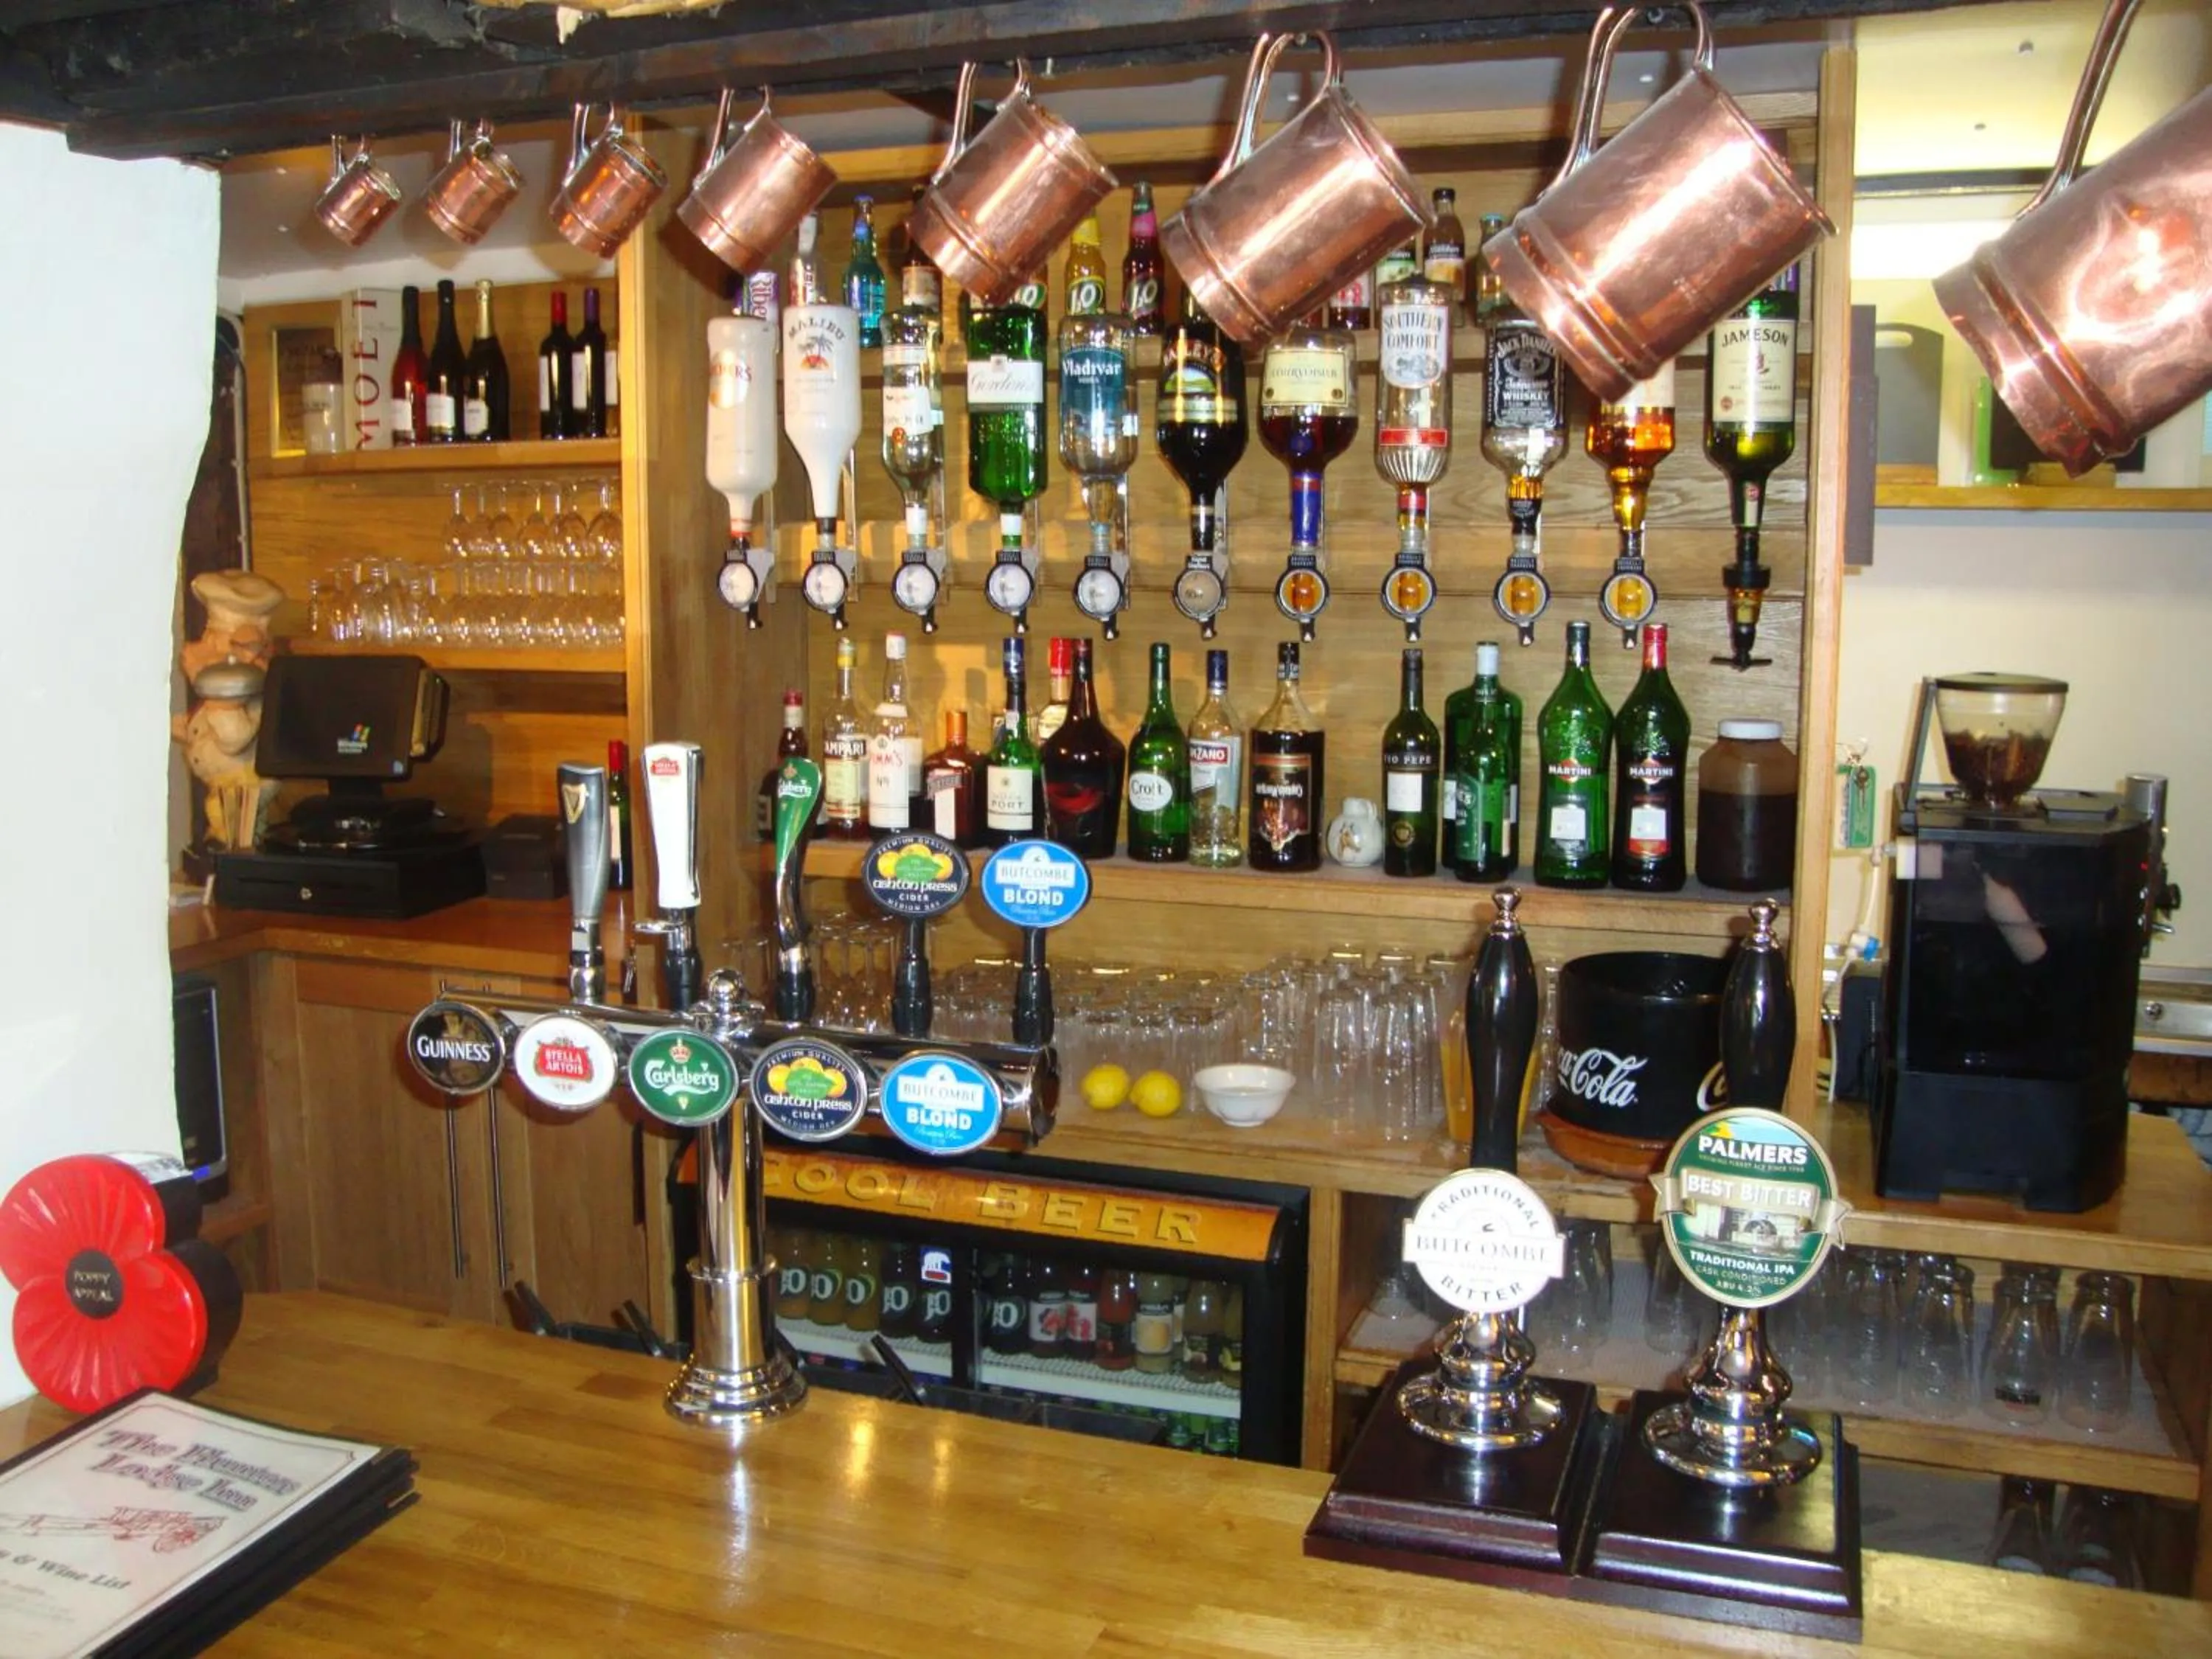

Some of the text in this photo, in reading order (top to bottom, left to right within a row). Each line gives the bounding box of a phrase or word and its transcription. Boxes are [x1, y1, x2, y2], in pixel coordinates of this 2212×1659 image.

[788, 318, 846, 340] MALIBU
[1722, 328, 1788, 347] JAMESON
[1387, 334, 1438, 349] COMFORT
[1062, 358, 1121, 377] Vladivar
[825, 740, 864, 756] AMPARI
[871, 751, 903, 767] IMM'S
[1404, 755, 1432, 765] PEPE
[1548, 765, 1591, 776] MARTINI
[1629, 767, 1673, 777] MARTINI
[992, 800, 1025, 809] PORT
[899, 893, 929, 901] CIDER
[1004, 888, 1064, 905] BLOND
[417, 1035, 491, 1062] GUINNESS
[545, 1048, 582, 1062] STELLA
[546, 1061, 584, 1074] ARTOIS
[644, 1060, 720, 1095] Carlsberg
[792, 1110, 824, 1120] CIDER
[906, 1107, 972, 1130] BLOND
[1698, 1135, 1808, 1165] PALMERS
[1688, 1174, 1812, 1208] BEST BITTER
[979, 1181, 1203, 1245] BEER
[1430, 1185, 1540, 1231] TRADITIONAL
[1416, 1234, 1545, 1261] BUTCOMBE
[1690, 1250, 1795, 1275] TRADITIONAL IPA
[74, 1270, 111, 1284] POPPY
[1696, 1265, 1787, 1286] CASK CONDITIONED
[1717, 1279, 1736, 1290] ABV
[1440, 1274, 1523, 1303] BITTER
[97, 1430, 178, 1457] The
[38, 1560, 89, 1581] Wine
[89, 1574, 131, 1590] List
